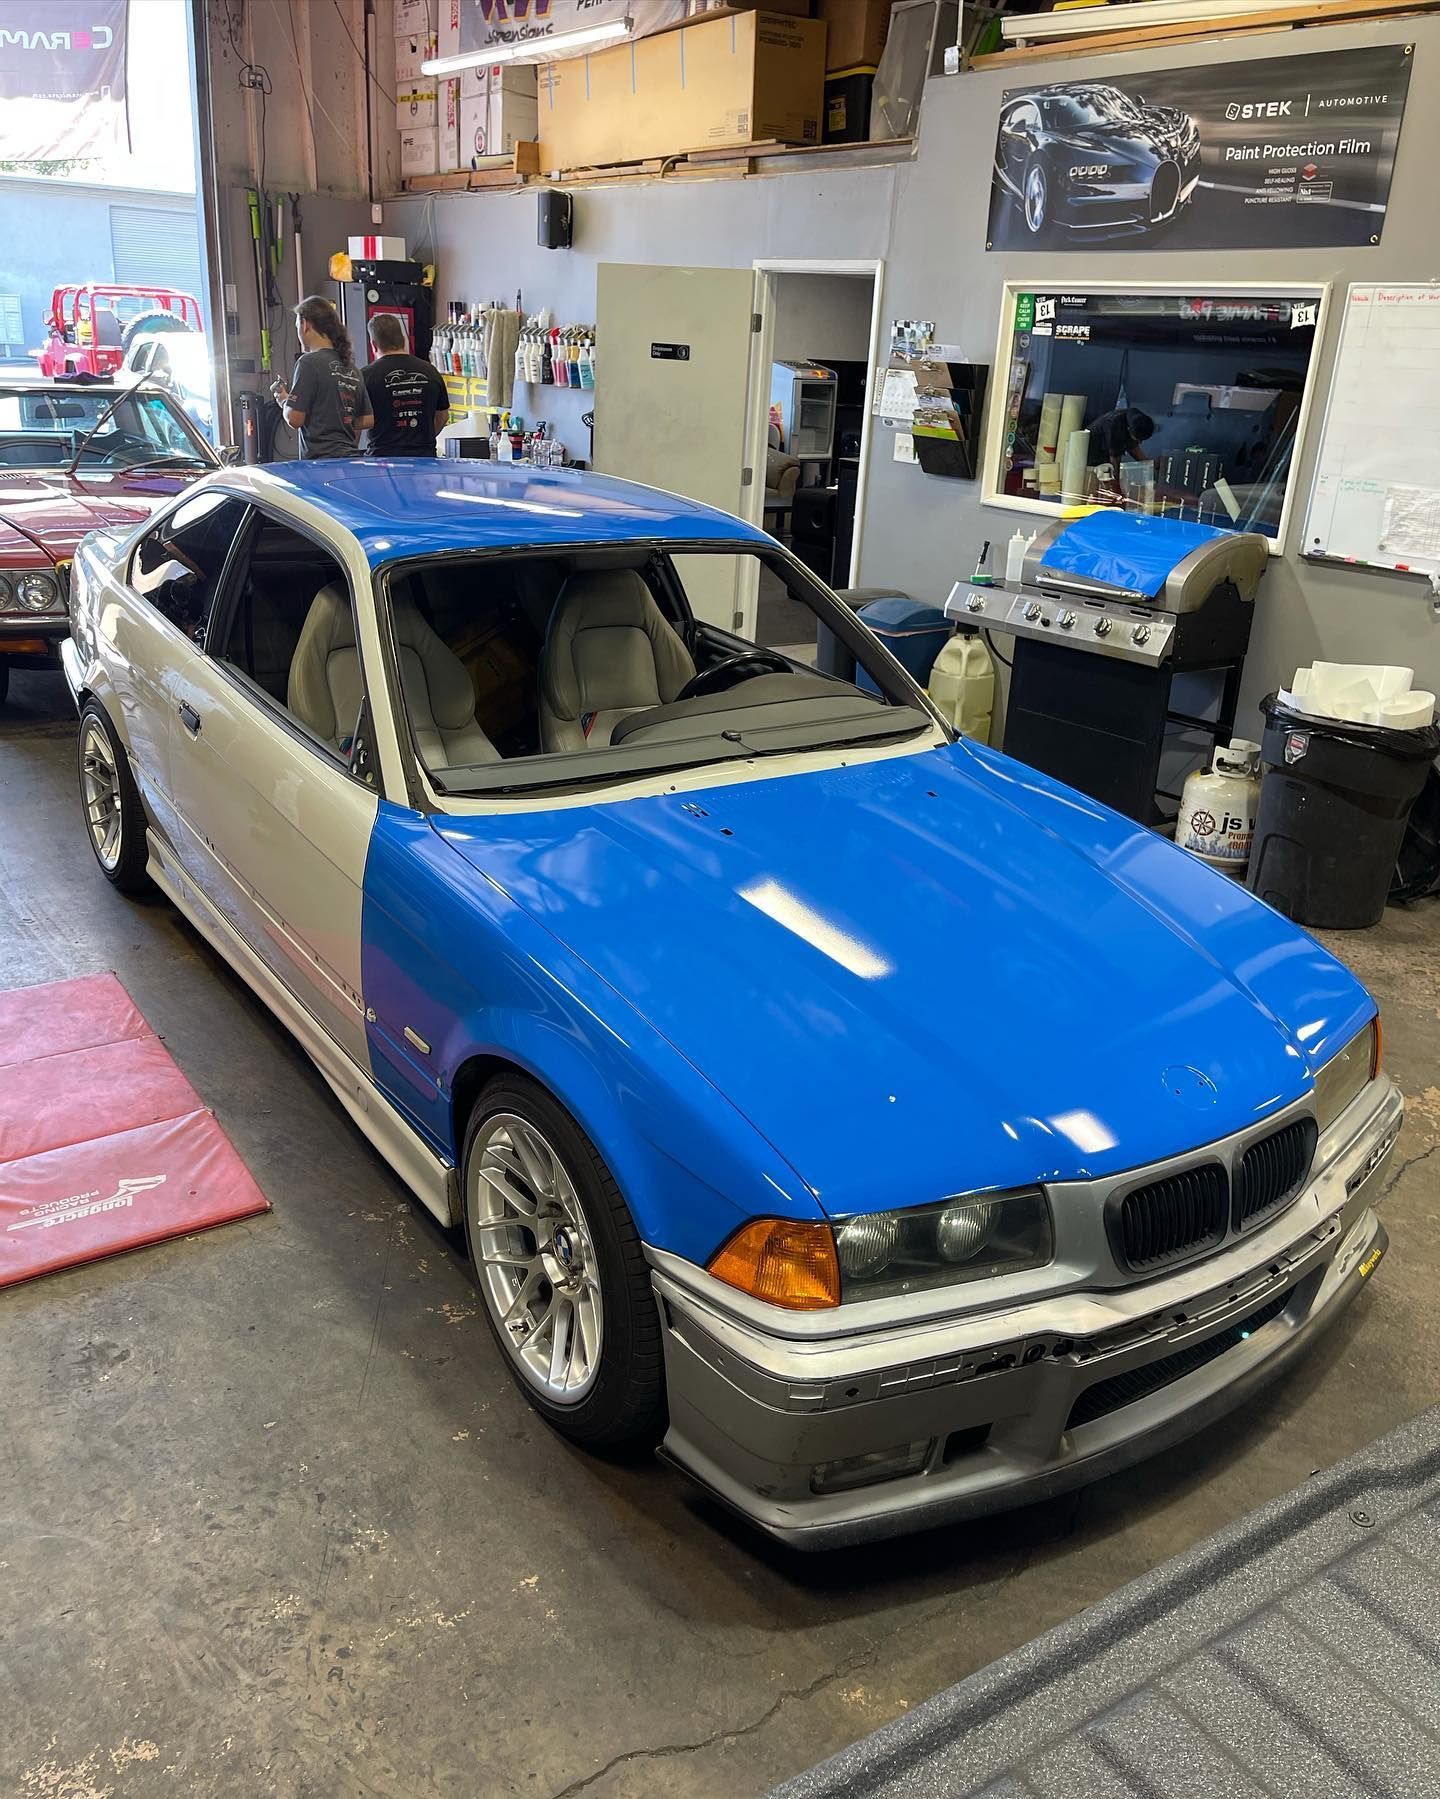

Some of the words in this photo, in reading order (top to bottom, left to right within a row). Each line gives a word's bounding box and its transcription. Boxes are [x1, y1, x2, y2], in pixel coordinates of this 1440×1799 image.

[1241, 100, 1293, 119] STEK
[1318, 95, 1388, 109] AUTOMOTIVE
[1225, 145, 1260, 161] Paint
[1263, 140, 1335, 159] Protection
[1338, 138, 1371, 154] Film
[1378, 292, 1413, 304] Description
[1040, 304, 1050, 316] 13
[1297, 310, 1309, 322] 13
[1055, 324, 1091, 334] SCRAPE
[1219, 812, 1242, 834] js
[19, 1189, 100, 1216] PRODUCTS
[33, 1198, 90, 1217] RACING
